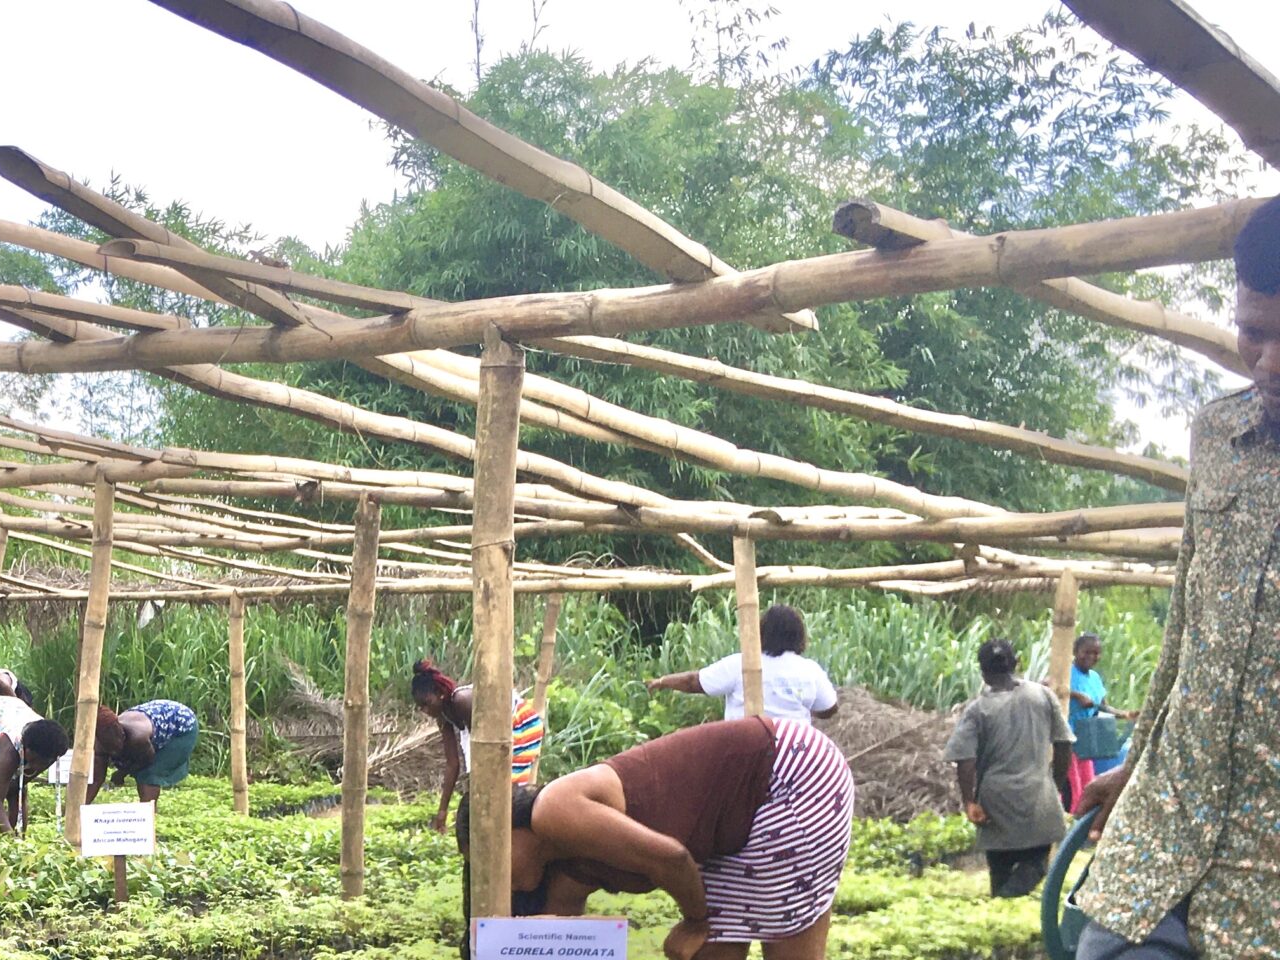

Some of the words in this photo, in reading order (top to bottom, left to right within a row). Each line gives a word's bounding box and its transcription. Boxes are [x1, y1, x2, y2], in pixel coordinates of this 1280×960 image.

[517, 932, 562, 941] Scientific
[565, 933, 596, 941] Name:
[500, 947, 553, 956] CEDRELA
[557, 947, 615, 957] ODORATA
